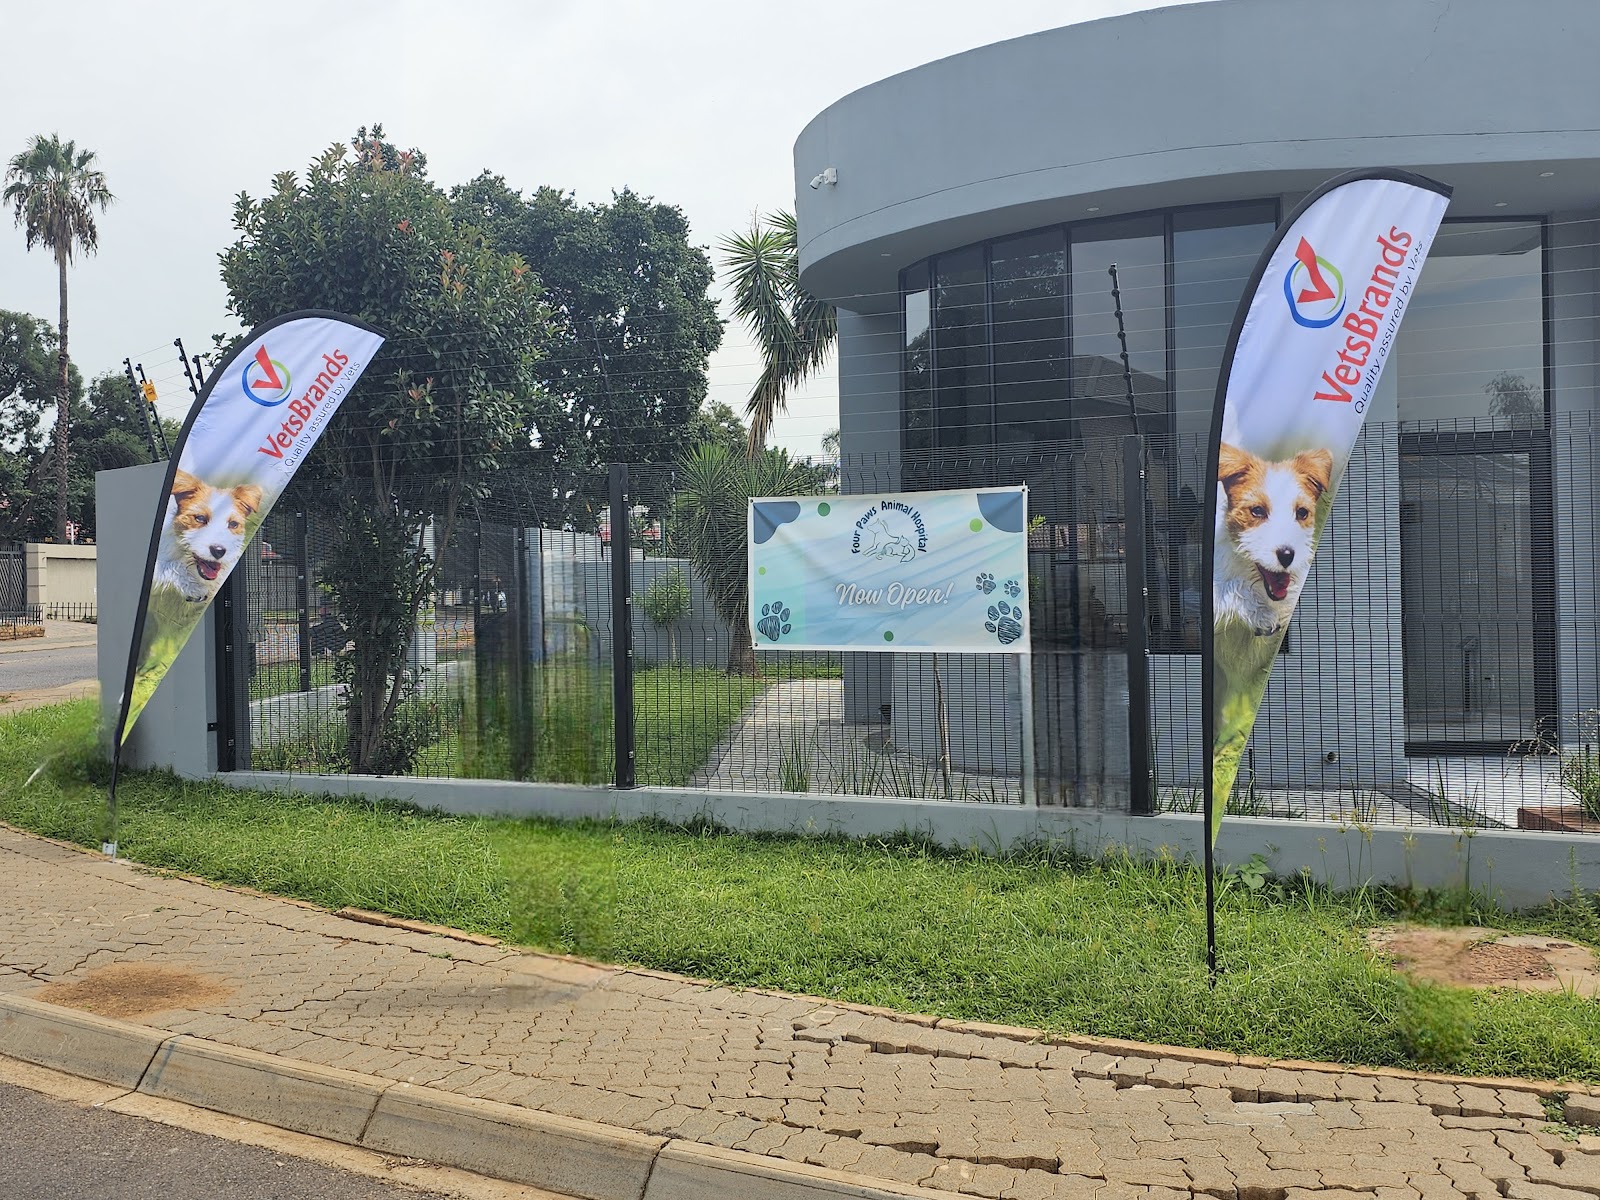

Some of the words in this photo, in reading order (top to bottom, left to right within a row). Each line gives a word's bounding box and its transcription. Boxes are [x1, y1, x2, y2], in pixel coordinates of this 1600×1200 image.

[1313, 225, 1413, 403] VetsBrands
[1354, 358, 1381, 415] Quality
[1378, 296, 1404, 357] assured
[1399, 274, 1413, 296] by
[257, 348, 349, 460] VetsBrands
[284, 433, 312, 467] Quality
[308, 396, 336, 433] assured
[332, 383, 346, 396] by
[341, 361, 361, 382] Vets
[855, 506, 877, 529] Paws
[881, 500, 914, 515] Animal
[851, 530, 861, 554] Four
[910, 511, 929, 553] Hospital
[835, 583, 883, 606] Now
[887, 581, 954, 610] Open!
